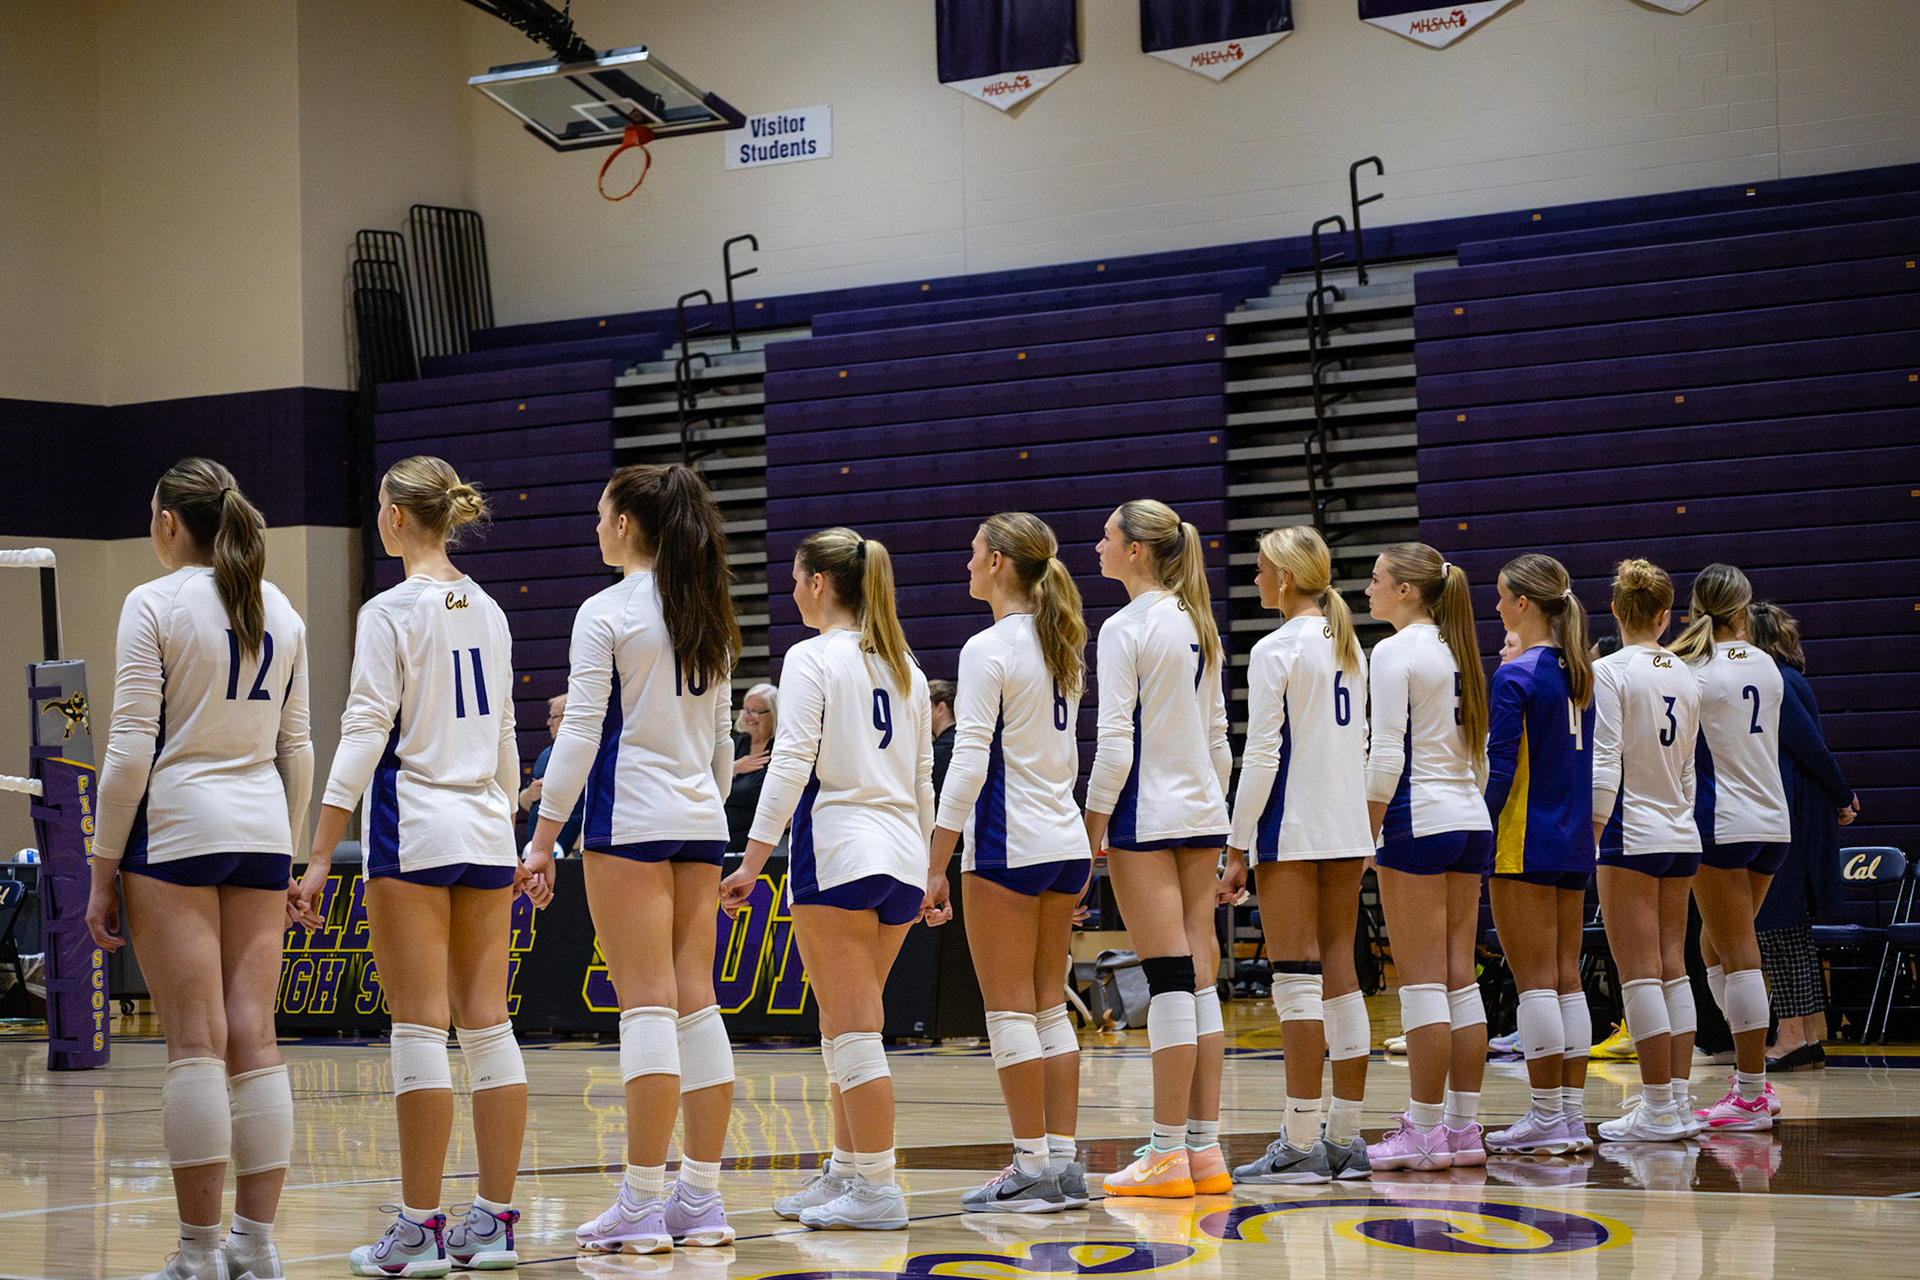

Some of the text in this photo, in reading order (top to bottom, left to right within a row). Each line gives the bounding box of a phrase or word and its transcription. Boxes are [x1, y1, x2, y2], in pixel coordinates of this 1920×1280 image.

[1409, 16, 1460, 35] MHSAA
[740, 138, 817, 163] Students
[750, 115, 806, 138] Visitor
[445, 591, 469, 610] Cal
[225, 628, 272, 700] 12
[1653, 655, 1672, 669] Cal
[1727, 648, 1748, 660] Cal
[452, 648, 490, 718] 11
[1053, 674, 1068, 731] 8
[1334, 670, 1351, 727] 6
[872, 688, 893, 749] 9
[1567, 696, 1583, 750] 4
[1659, 695, 1677, 747] 3
[1742, 685, 1763, 735] 2
[1843, 853, 1882, 880] Cal
[77, 774, 104, 1052] FIGH SCOTS
